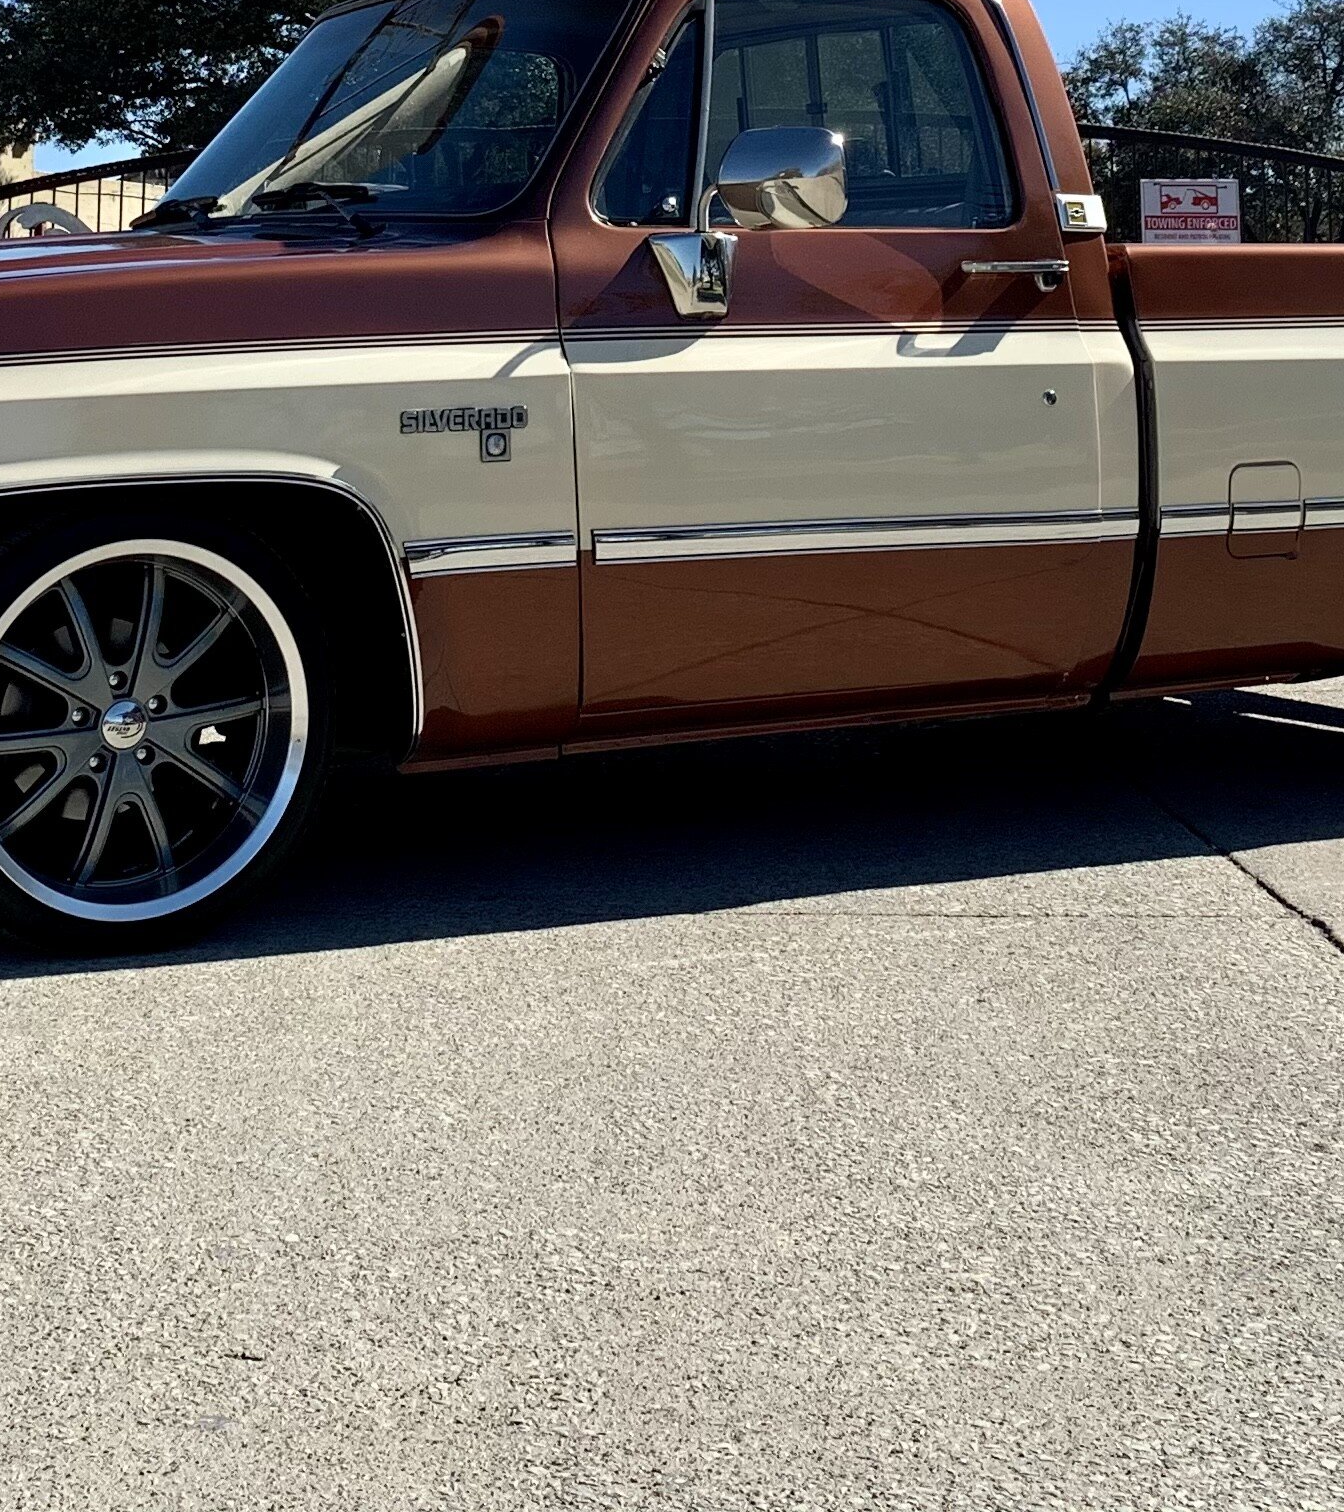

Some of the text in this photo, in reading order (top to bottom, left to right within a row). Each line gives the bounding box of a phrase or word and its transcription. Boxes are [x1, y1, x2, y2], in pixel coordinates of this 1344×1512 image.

[1146, 217, 1236, 229] TOWING ENFORCED
[400, 405, 528, 434] SILVERADO
